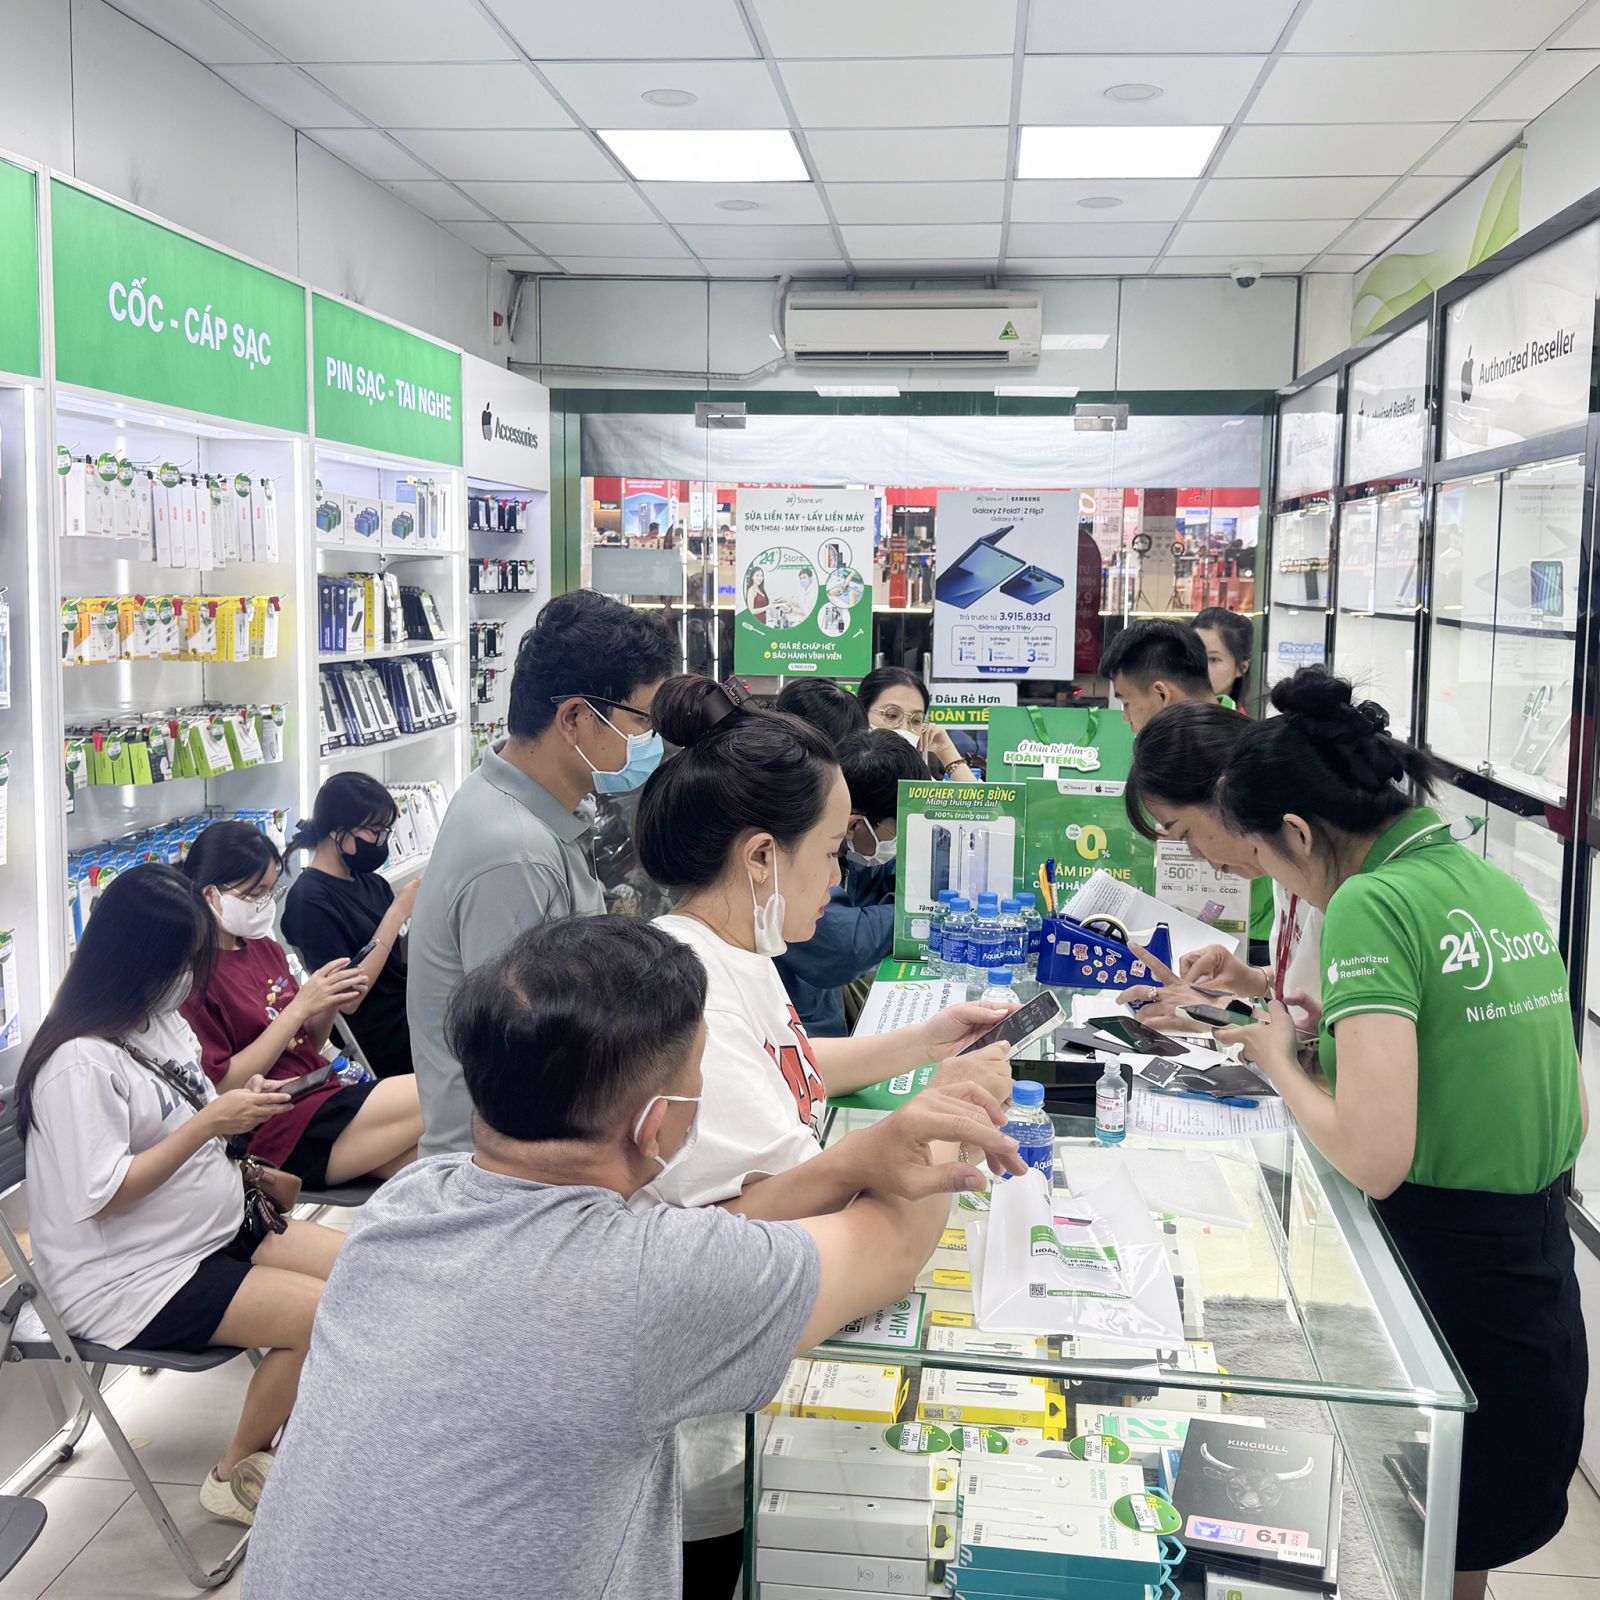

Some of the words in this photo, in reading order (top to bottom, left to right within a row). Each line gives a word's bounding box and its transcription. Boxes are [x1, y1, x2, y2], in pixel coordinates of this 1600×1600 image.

[108, 276, 164, 333] CỐC
[185, 304, 228, 351] CÁP
[232, 323, 271, 370] SẠC
[1479, 342, 1529, 386] Authorized
[1530, 329, 1575, 367] Reseller
[326, 356, 352, 392] PIN
[356, 366, 385, 406] SẠC
[395, 379, 415, 410] TAI
[419, 386, 452, 421] NGHE
[494, 416, 539, 449] Accessories
[785, 512, 800, 521] TAY
[845, 511, 864, 521] MÁY
[972, 507, 997, 516] Galaxy
[1029, 507, 1044, 516] Flip7
[785, 524, 799, 533] MÁY
[759, 551, 775, 564] 24
[960, 613, 970, 621] Trả
[999, 612, 1051, 622] 3.915.833đ
[779, 642, 791, 650] GIÁ
[1027, 649, 1036, 662] 3
[935, 693, 958, 704] Đâu
[961, 693, 975, 704] Rẻ
[978, 694, 1001, 704] Hơn
[1030, 744, 1048, 753] Đâu
[1064, 746, 1083, 755] Hơn
[909, 786, 955, 800] VOUCHER
[949, 799, 972, 809] tháng
[934, 811, 953, 819] 100%
[1076, 824, 1107, 859] 0
[1168, 867, 1194, 880] 500
[1340, 955, 1389, 967] Authorized
[1340, 967, 1376, 979] Reseller
[1466, 1002, 1506, 1022] Niềm
[1509, 1001, 1523, 1015] tin
[888, 1312, 910, 1338] WIFI
[1228, 1439, 1289, 1453] KINGBULL
[1256, 1529, 1287, 1545] 6.1
